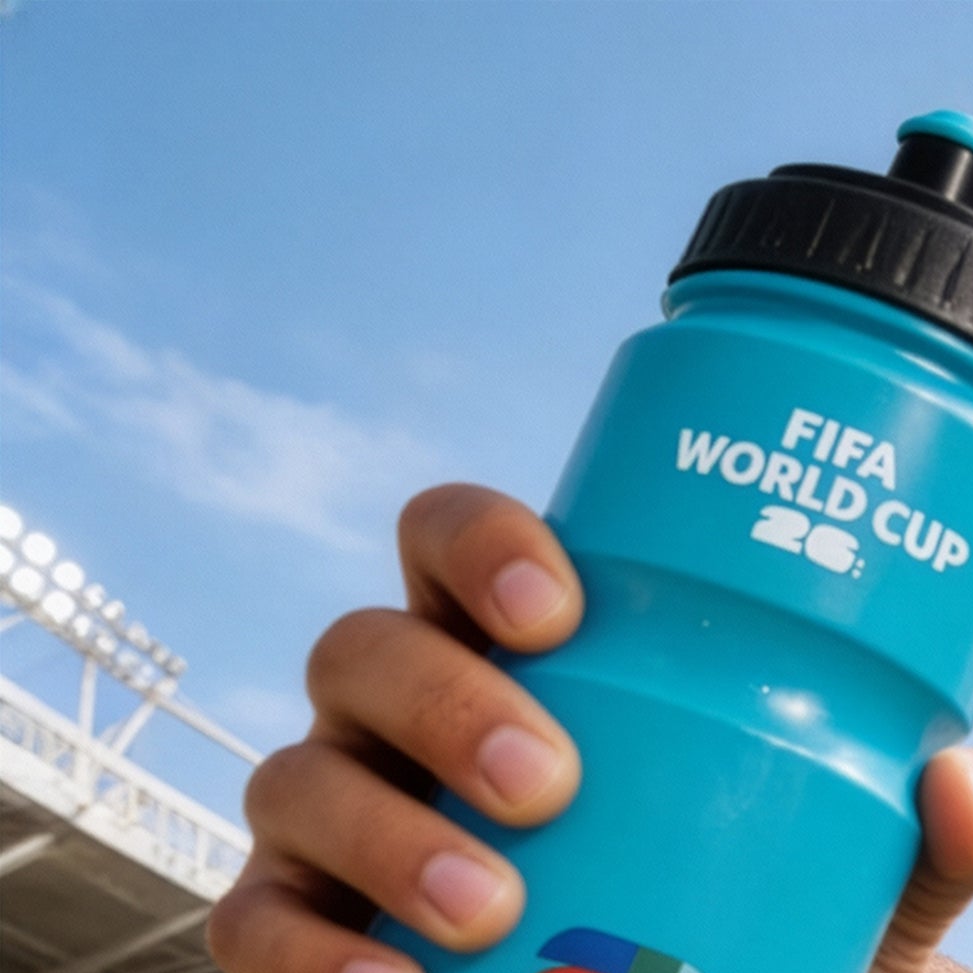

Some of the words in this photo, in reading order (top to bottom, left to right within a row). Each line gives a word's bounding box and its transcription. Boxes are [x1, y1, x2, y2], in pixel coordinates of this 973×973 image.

[675, 428, 868, 522] WORLD
[872, 499, 970, 573] CUP
[781, 407, 896, 491] FIFA
